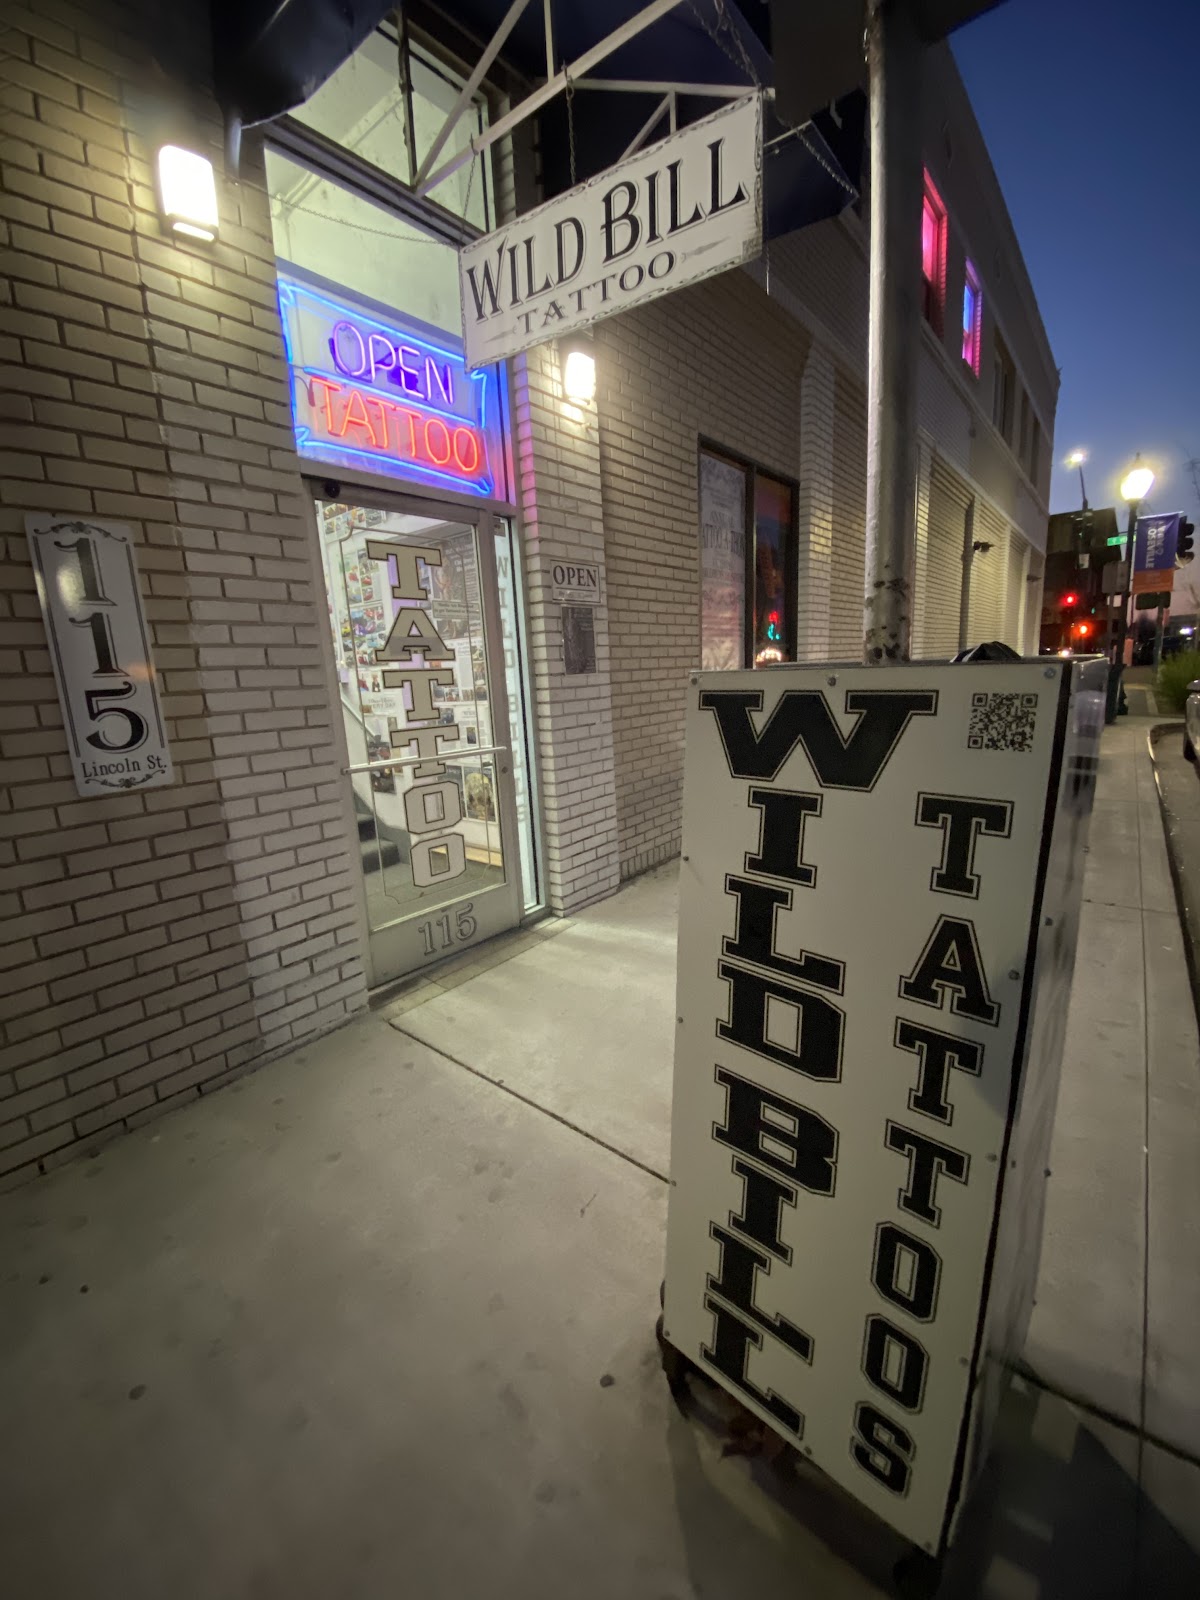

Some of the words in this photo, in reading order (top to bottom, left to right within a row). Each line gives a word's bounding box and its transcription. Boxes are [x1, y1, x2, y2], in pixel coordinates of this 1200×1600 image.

[466, 215, 587, 325] WILD
[600, 137, 750, 267] BILL
[516, 251, 677, 335] TATTOO
[332, 320, 454, 404] OPEN
[310, 375, 479, 472] TATTOO
[553, 565, 597, 587] OPEN
[366, 539, 468, 889] TATTOO
[82, 758, 141, 779] Lincoln
[147, 754, 168, 771] St.
[418, 902, 478, 957] 115
[700, 690, 939, 1083] WILD
[849, 791, 1015, 1499] TATTOOS
